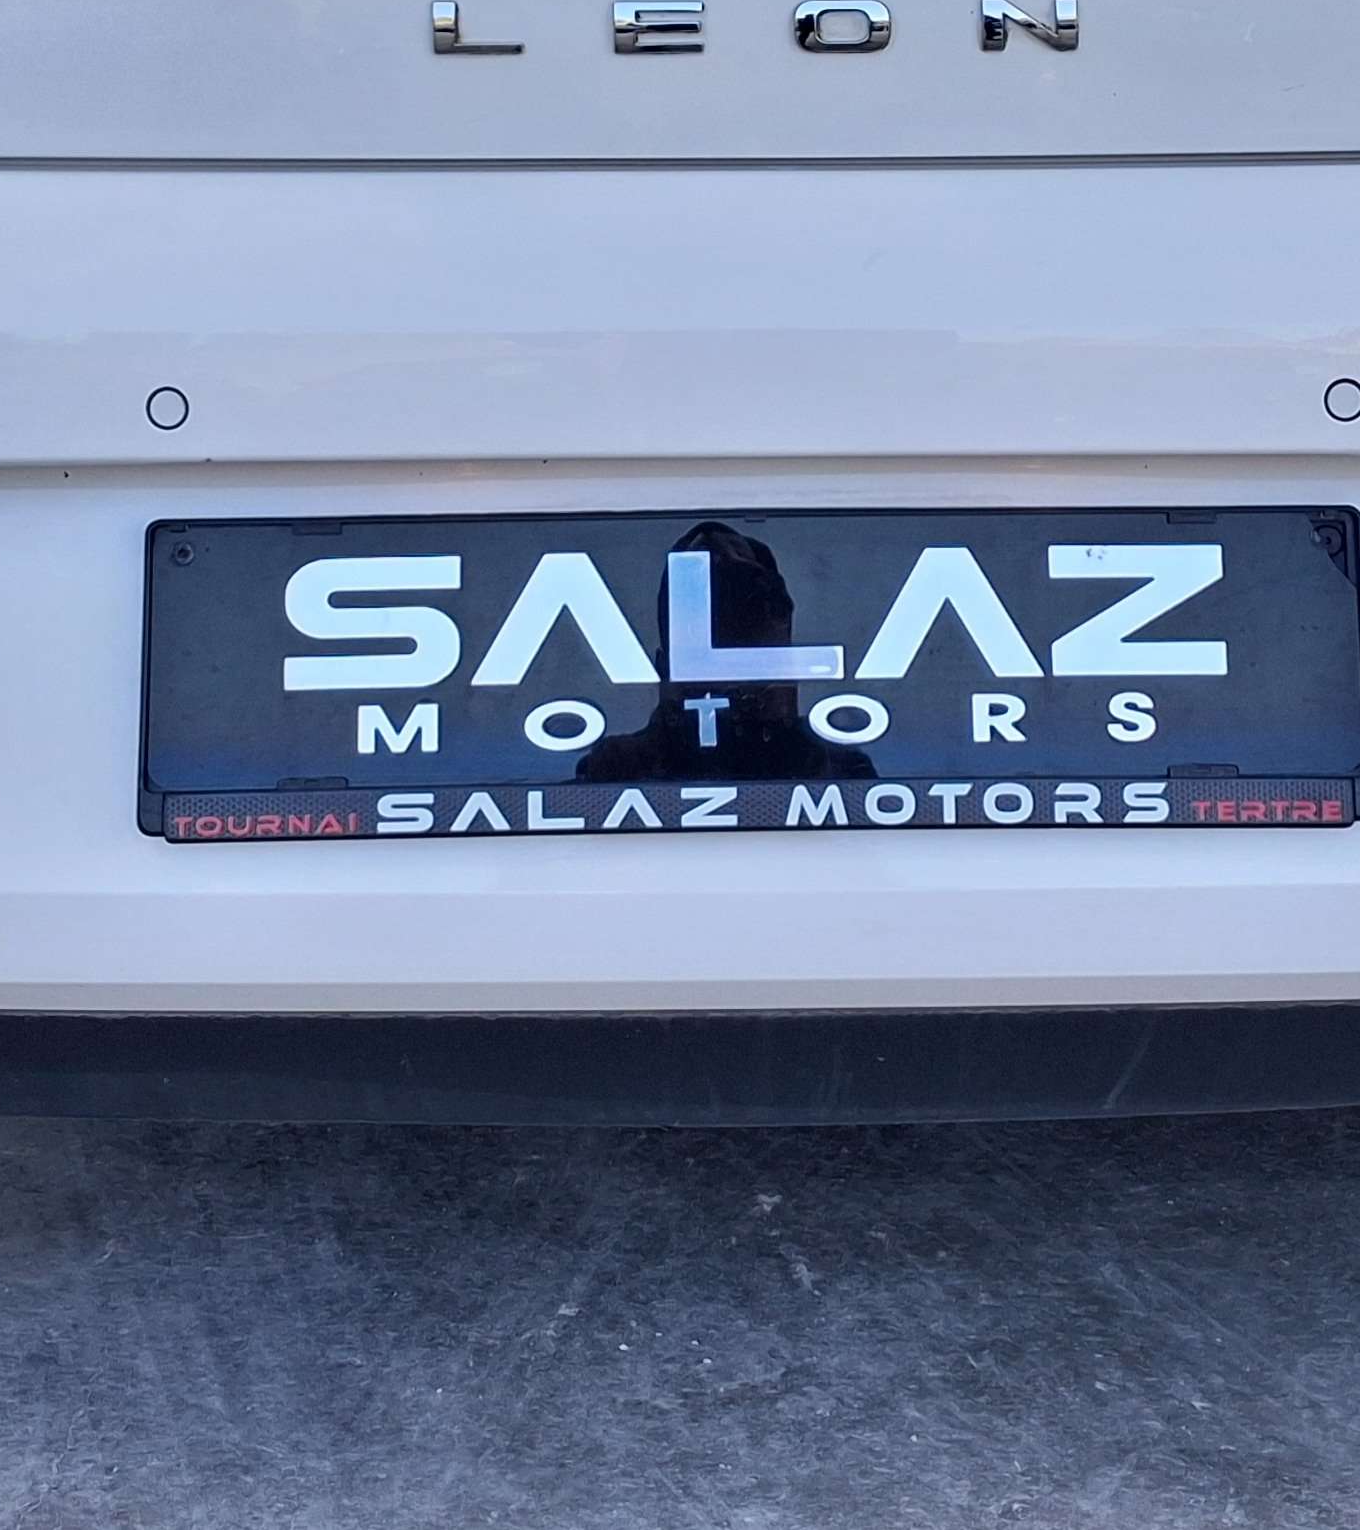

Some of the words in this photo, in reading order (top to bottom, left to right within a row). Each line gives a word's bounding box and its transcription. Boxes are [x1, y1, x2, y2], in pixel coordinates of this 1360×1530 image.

[283, 544, 1228, 691] SALAZ
[356, 691, 1159, 754] MOTORS
[172, 813, 359, 838] TOURNAI
[376, 786, 739, 834] SALAZ
[785, 781, 1171, 826] MOTORS
[1192, 800, 1344, 822] TERTRE
